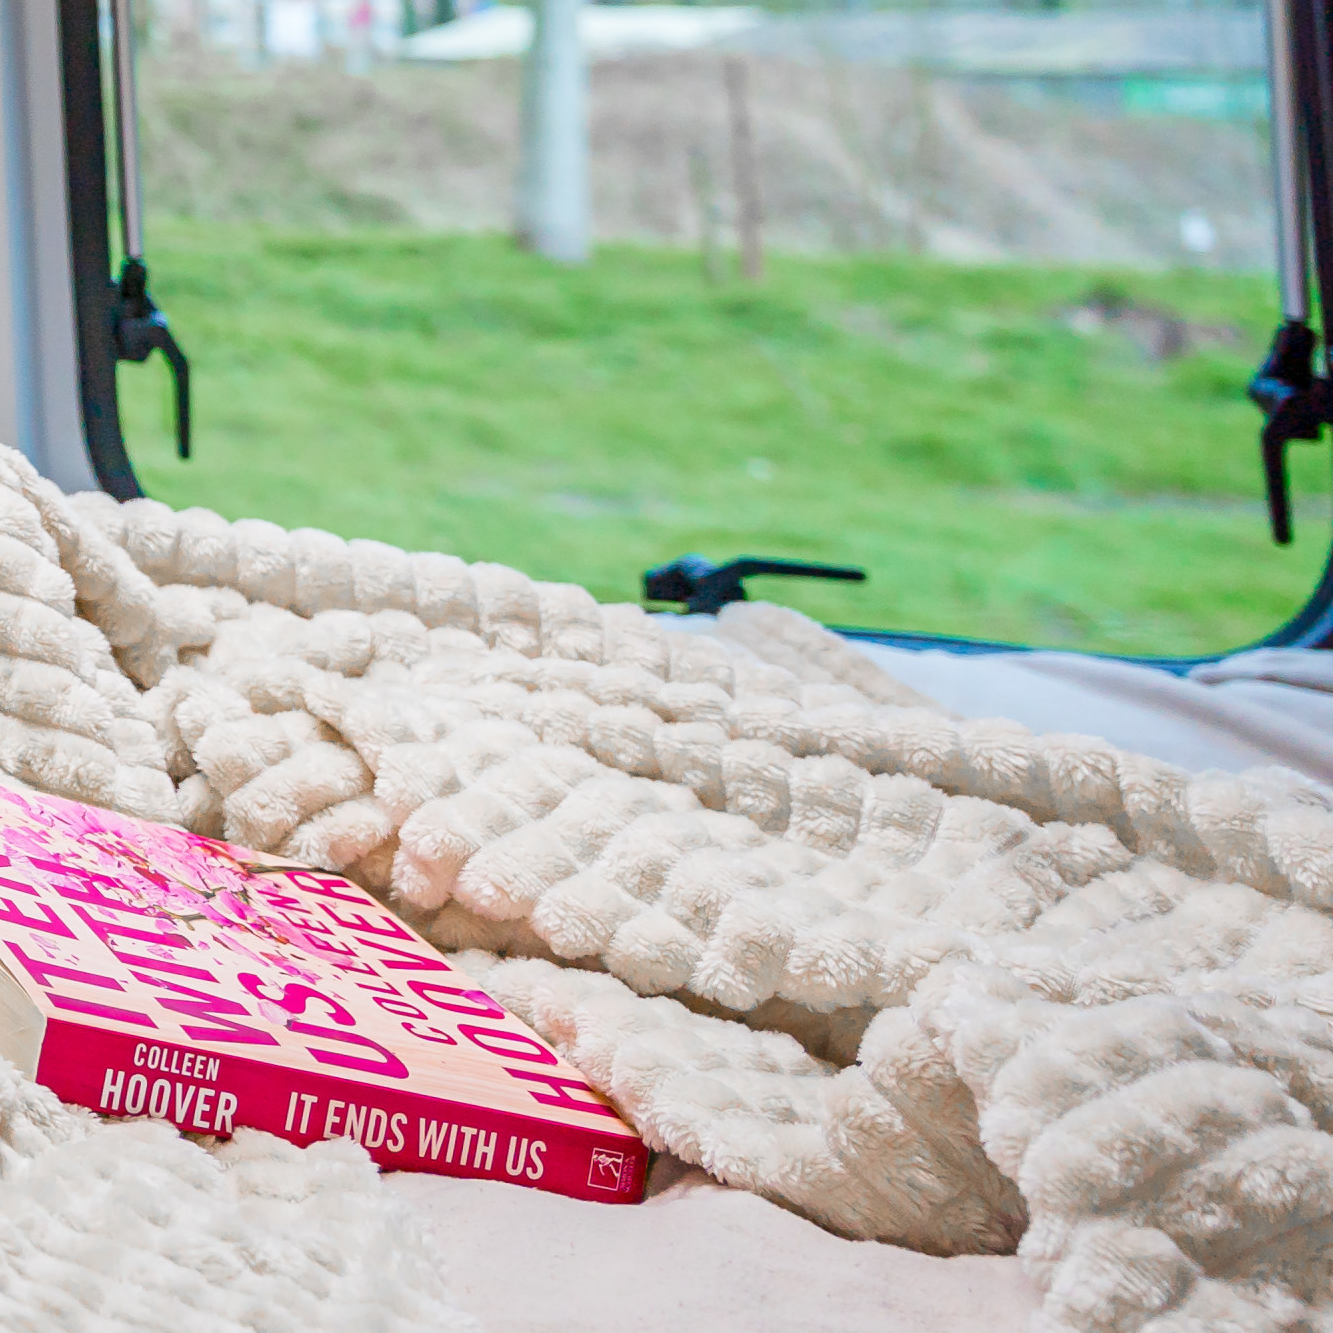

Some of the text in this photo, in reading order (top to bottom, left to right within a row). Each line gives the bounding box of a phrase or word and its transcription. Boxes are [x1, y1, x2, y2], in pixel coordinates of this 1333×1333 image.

[2, 939, 159, 1029] IT
[28, 856, 281, 1046] WITH
[257, 889, 458, 1046] COLLEEN
[285, 871, 622, 1118] HOOVER
[134, 1043, 220, 1082] COLLEEN
[237, 972, 409, 1079] US
[100, 1068, 238, 1134] HOOVER
[285, 1091, 547, 1180] IT ENDS WITH US
